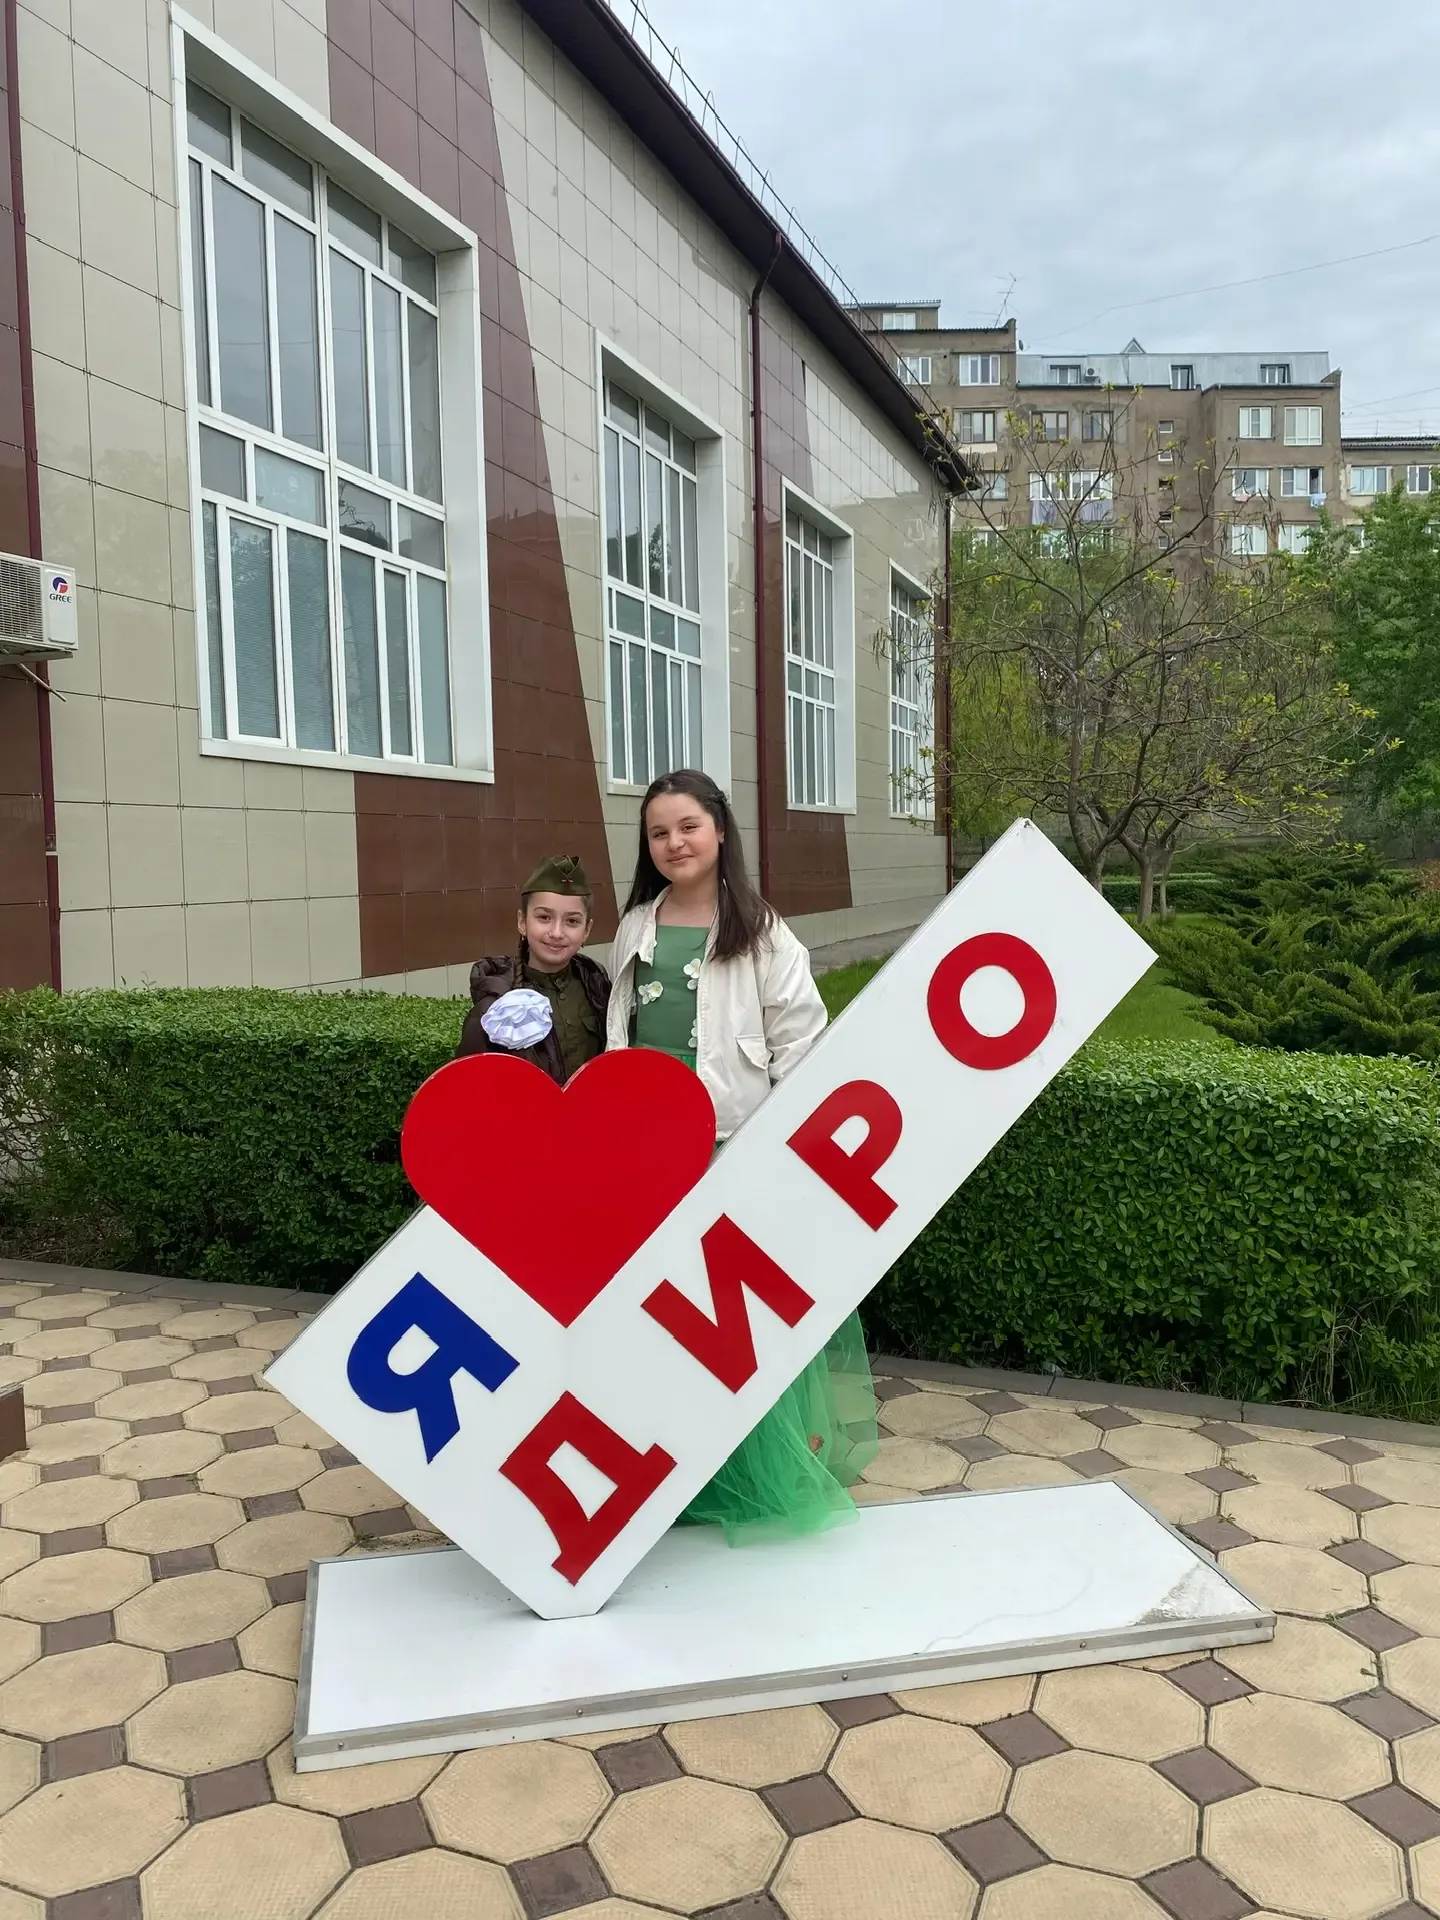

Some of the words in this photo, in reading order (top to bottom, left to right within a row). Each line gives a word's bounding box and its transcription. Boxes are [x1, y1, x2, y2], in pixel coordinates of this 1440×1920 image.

[49, 593, 72, 603] GREE
[500, 932, 1057, 1585] ДИРО
[346, 1272, 519, 1464] Я
